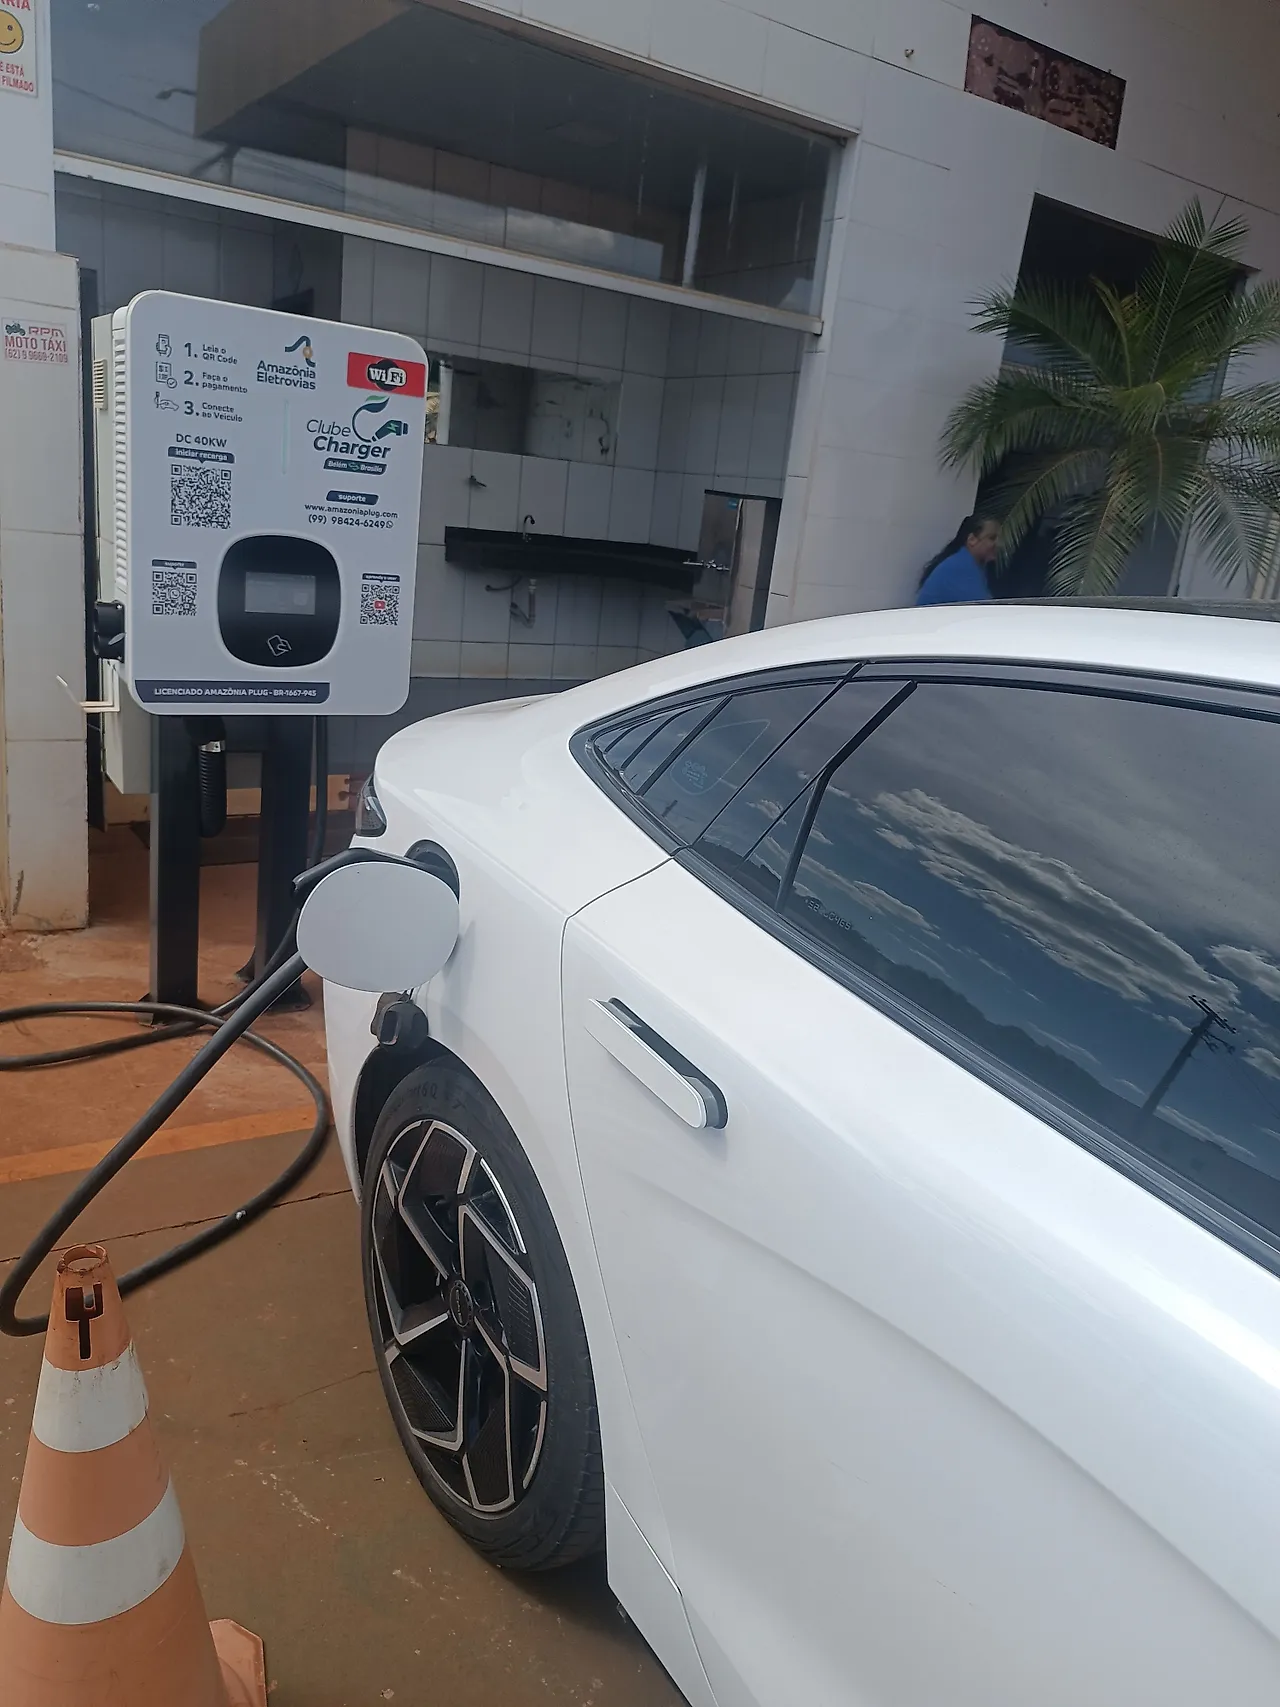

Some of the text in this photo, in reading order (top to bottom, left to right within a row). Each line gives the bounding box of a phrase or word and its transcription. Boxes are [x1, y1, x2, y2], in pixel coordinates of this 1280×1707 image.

[2, 75, 34, 92] FILMADO
[5, 336, 66, 352] MOTO TÁXI
[184, 342, 198, 358] 1.
[203, 344, 219, 353] Leia
[202, 352, 237, 364] QR Code
[257, 360, 316, 378] Amazônia
[184, 370, 199, 386] 2.
[202, 372, 220, 382] Faça
[257, 372, 316, 390] Eletrovias
[202, 381, 248, 393] pagamento
[184, 400, 234, 416] 3. Conecte
[306, 419, 351, 437] Clube
[176, 433, 227, 447] DC 40KW
[314, 436, 391, 460] Charger
[200, 452, 228, 461] recarga
[338, 494, 366, 502] suporte
[304, 504, 398, 519] www.amazoniaplug.com
[308, 514, 385, 529] (99) 98424-6249
[204, 687, 247, 696] AMAZÔNIA
